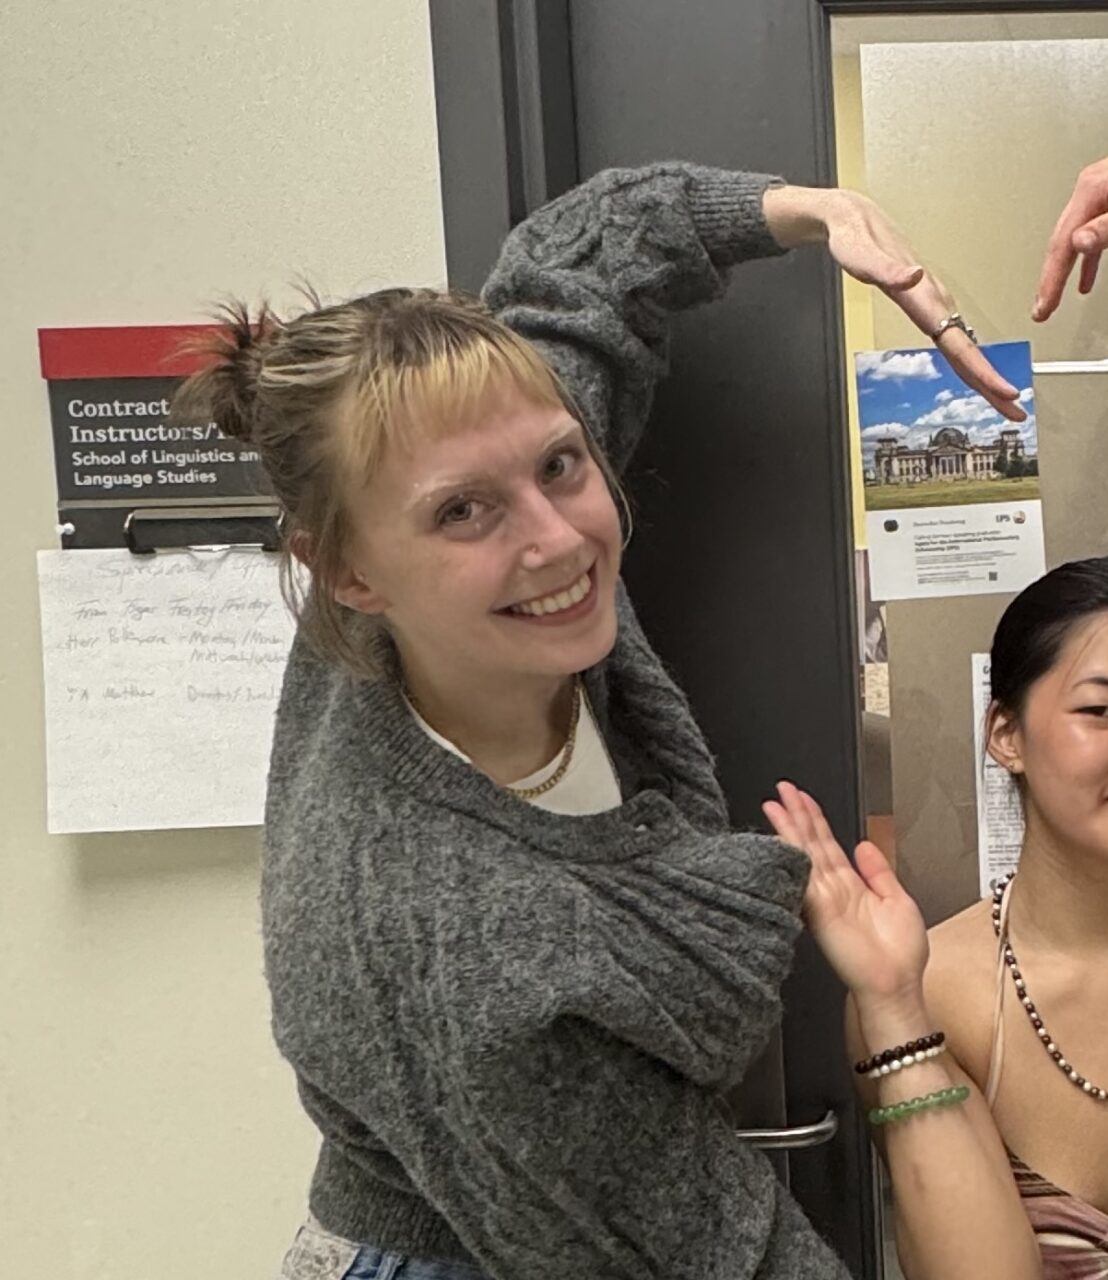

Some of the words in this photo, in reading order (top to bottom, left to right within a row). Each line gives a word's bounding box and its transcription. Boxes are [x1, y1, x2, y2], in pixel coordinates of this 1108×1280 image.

[68, 399, 170, 418] Contract
[70, 422, 237, 444] Instructors/T
[72, 452, 126, 466] School
[131, 450, 148, 464] of
[152, 449, 236, 467] Linguistics
[239, 450, 262, 463] an
[74, 472, 153, 489] Language
[157, 469, 217, 484] Studies
